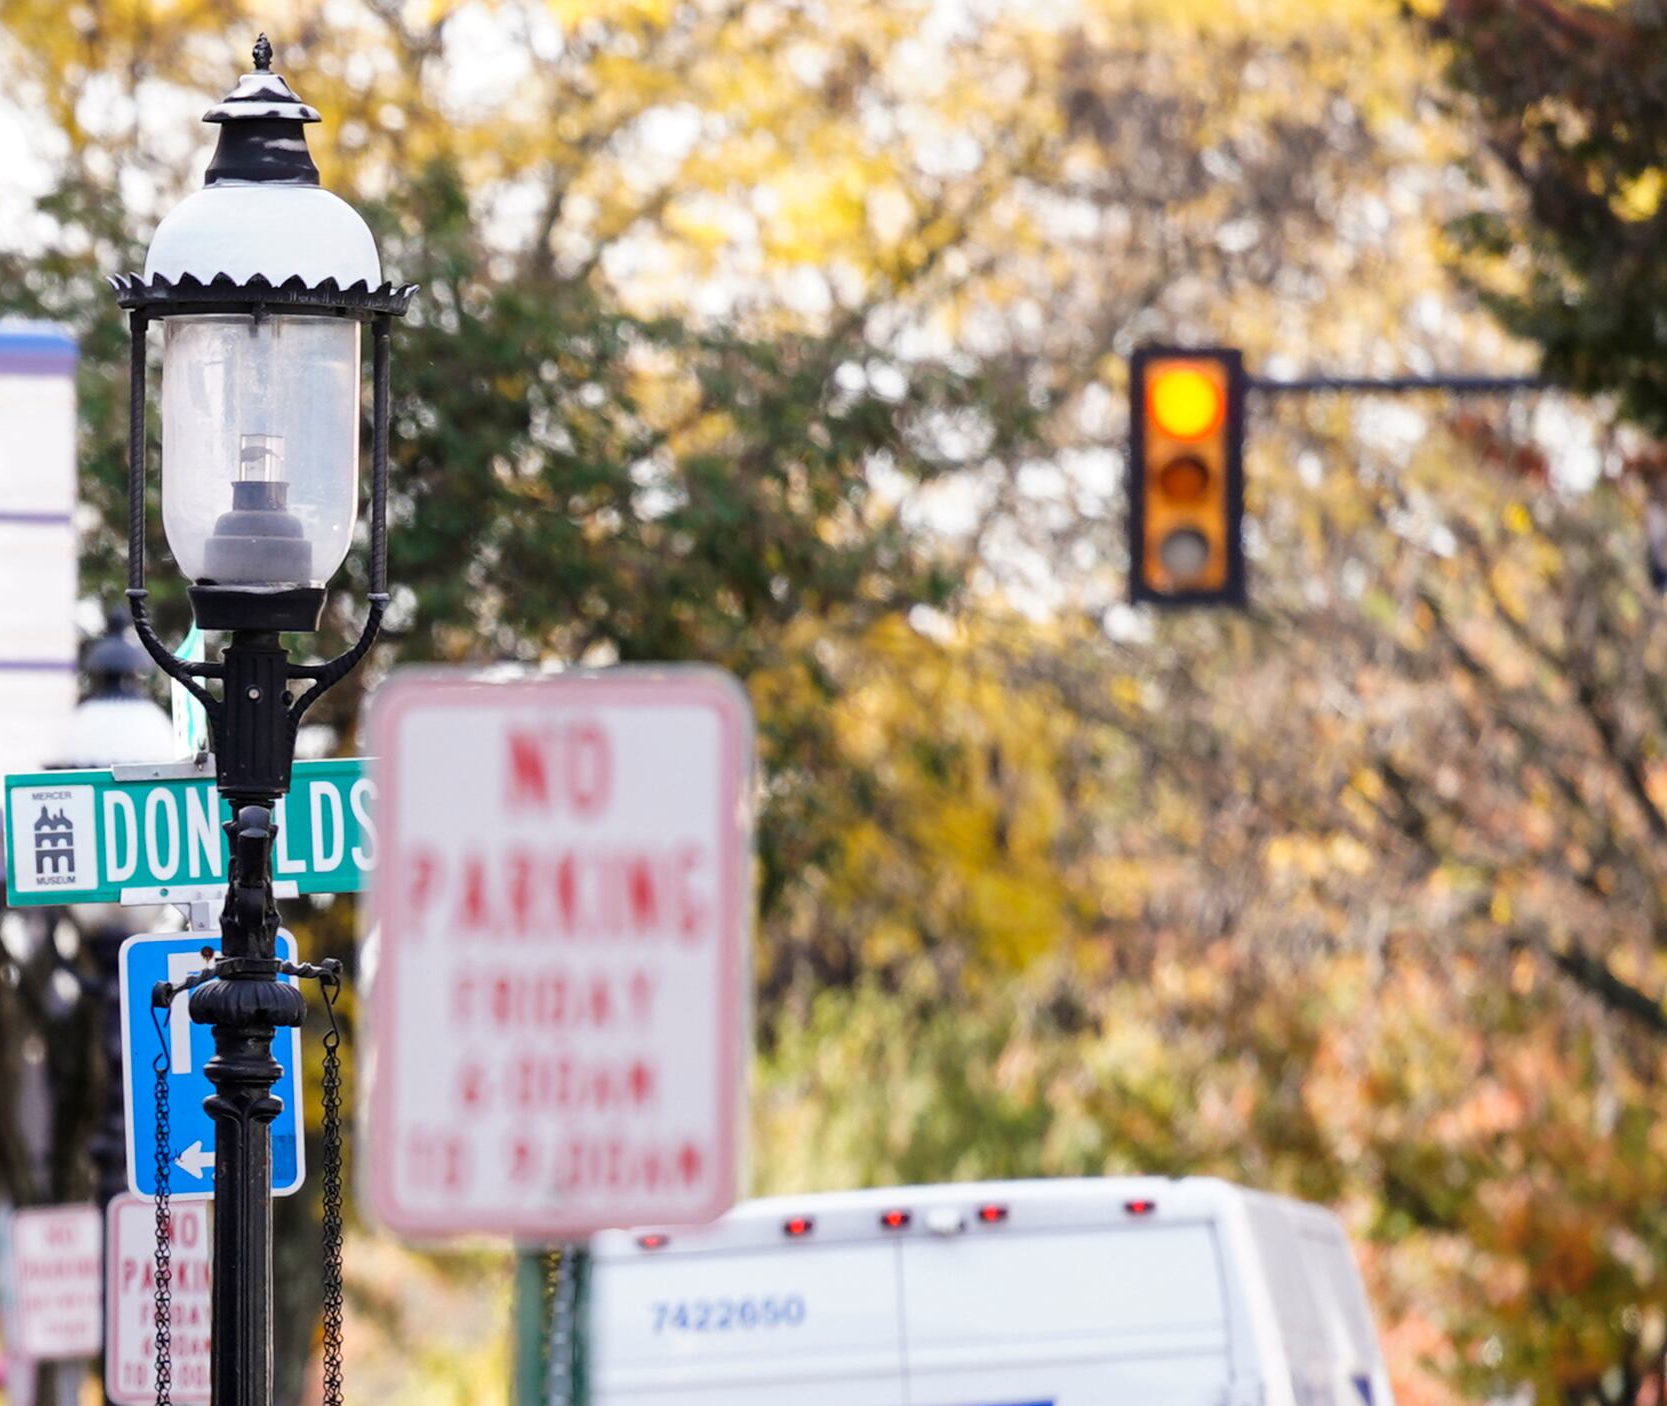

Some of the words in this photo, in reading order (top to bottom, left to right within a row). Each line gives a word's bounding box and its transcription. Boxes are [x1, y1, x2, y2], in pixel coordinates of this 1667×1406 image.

[32, 791, 72, 801] MERCER
[505, 727, 614, 820] NO
[103, 777, 379, 883] DONLDS
[36, 876, 76, 885] MUSEUM
[409, 842, 708, 945] PARKING
[454, 967, 654, 1029] FRIDAY
